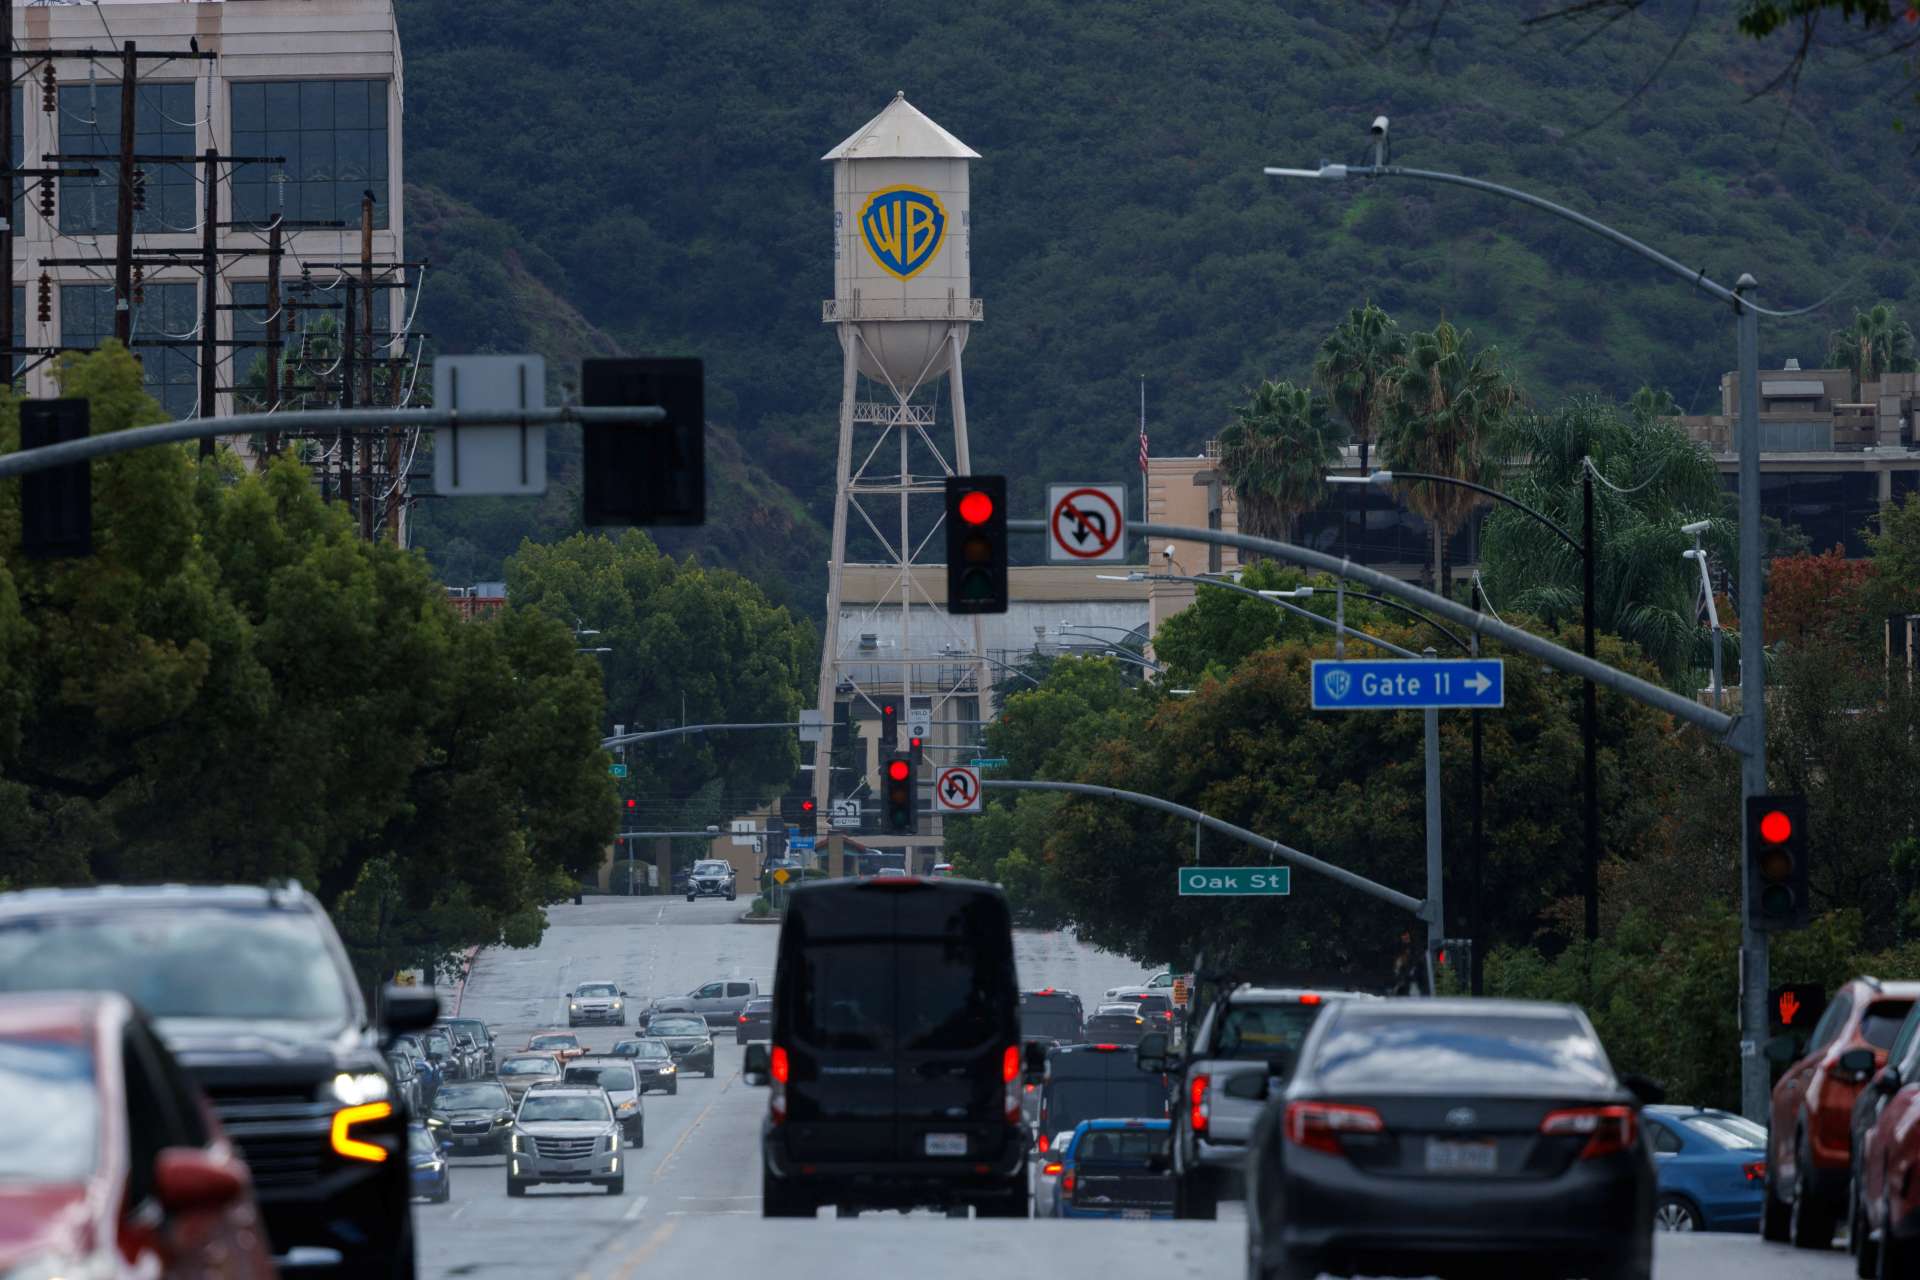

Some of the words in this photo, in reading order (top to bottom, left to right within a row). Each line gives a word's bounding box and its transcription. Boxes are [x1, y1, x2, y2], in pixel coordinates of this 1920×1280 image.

[868, 199, 936, 266] WB
[1361, 672, 1421, 696] Gate
[1434, 672, 1451, 695] 11
[1189, 874, 1238, 889] Oak
[1249, 874, 1280, 889] St
